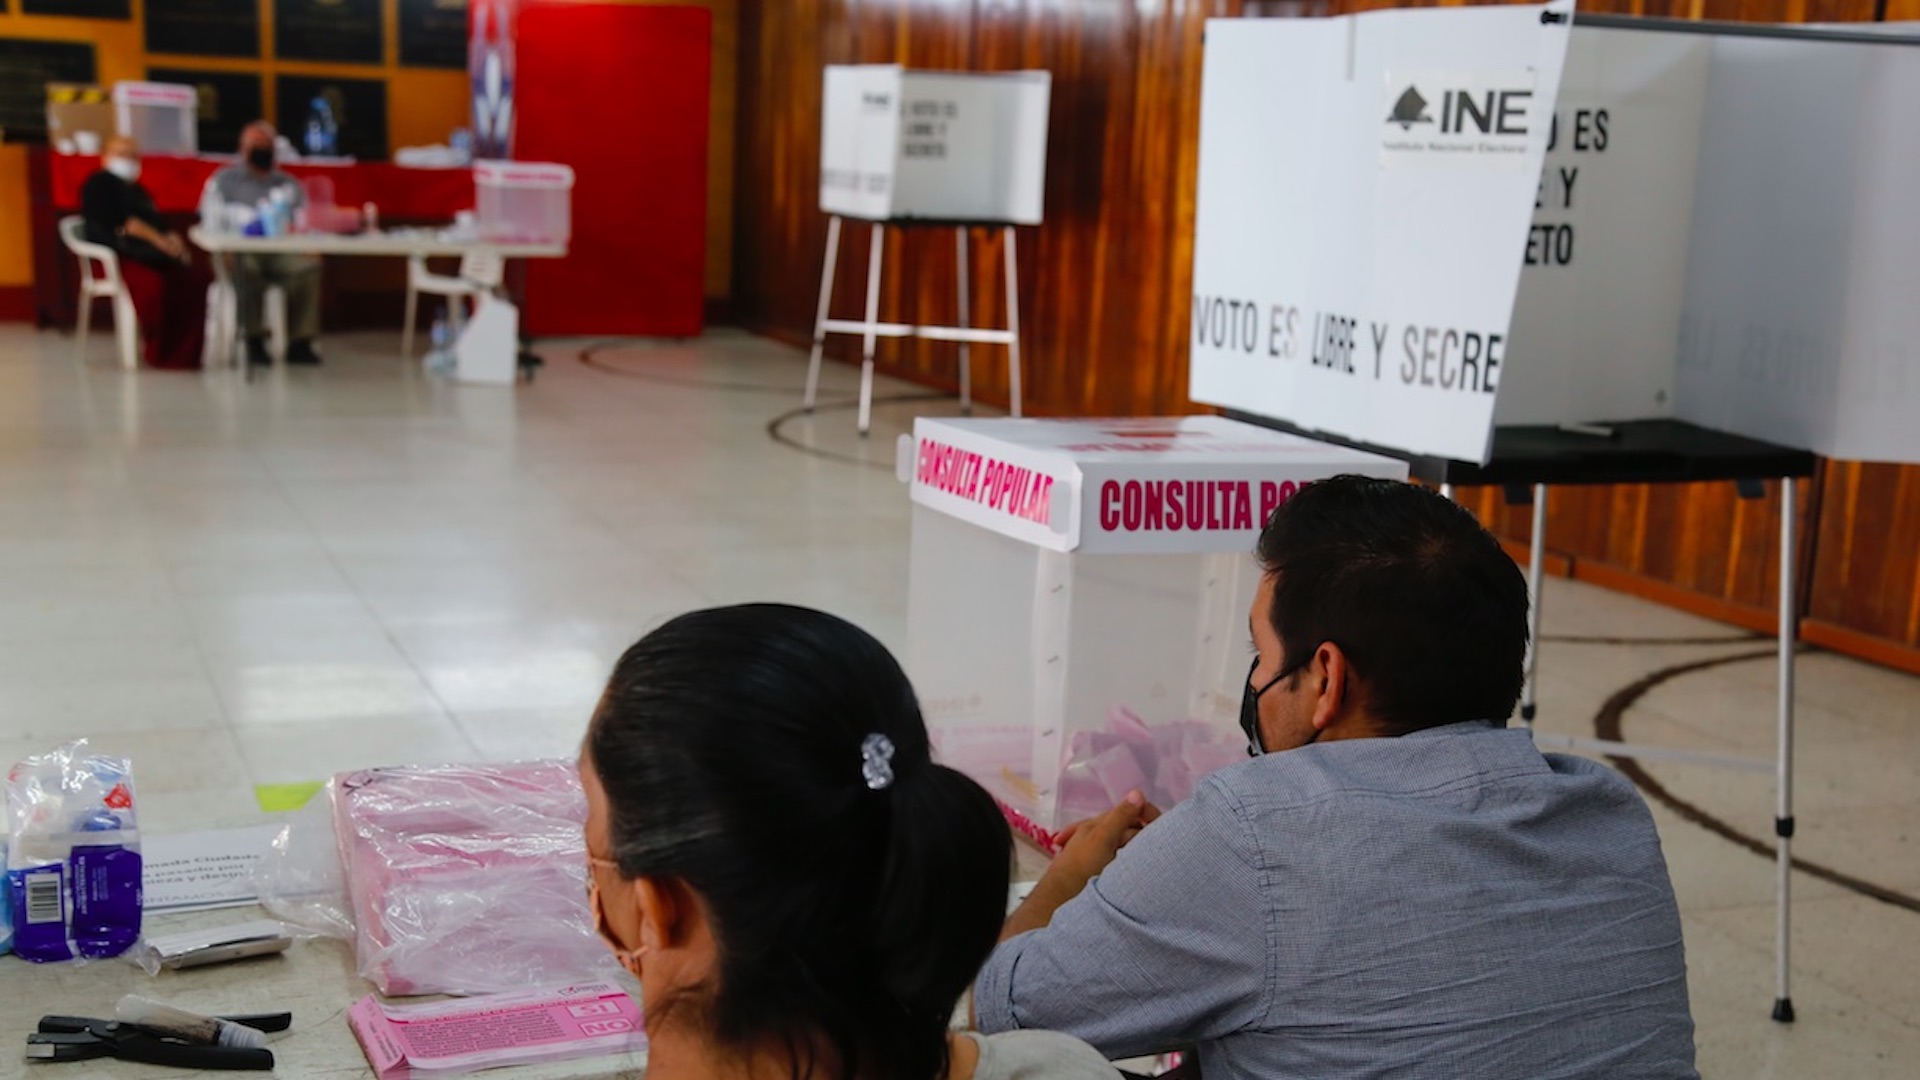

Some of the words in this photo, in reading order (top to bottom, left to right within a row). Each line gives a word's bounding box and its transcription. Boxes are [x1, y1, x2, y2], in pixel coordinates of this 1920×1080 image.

[1440, 91, 1533, 134] INE
[1574, 109, 1609, 151] ES
[1560, 166, 1579, 208] Y
[1194, 294, 1259, 354] VOTO
[1268, 305, 1299, 361] ES
[1312, 311, 1357, 374] LIBRE
[1371, 322, 1388, 381] Y
[1401, 325, 1504, 394] SECRE
[917, 438, 983, 502] CONSULTA
[1100, 479, 1253, 532] CONSULTA
